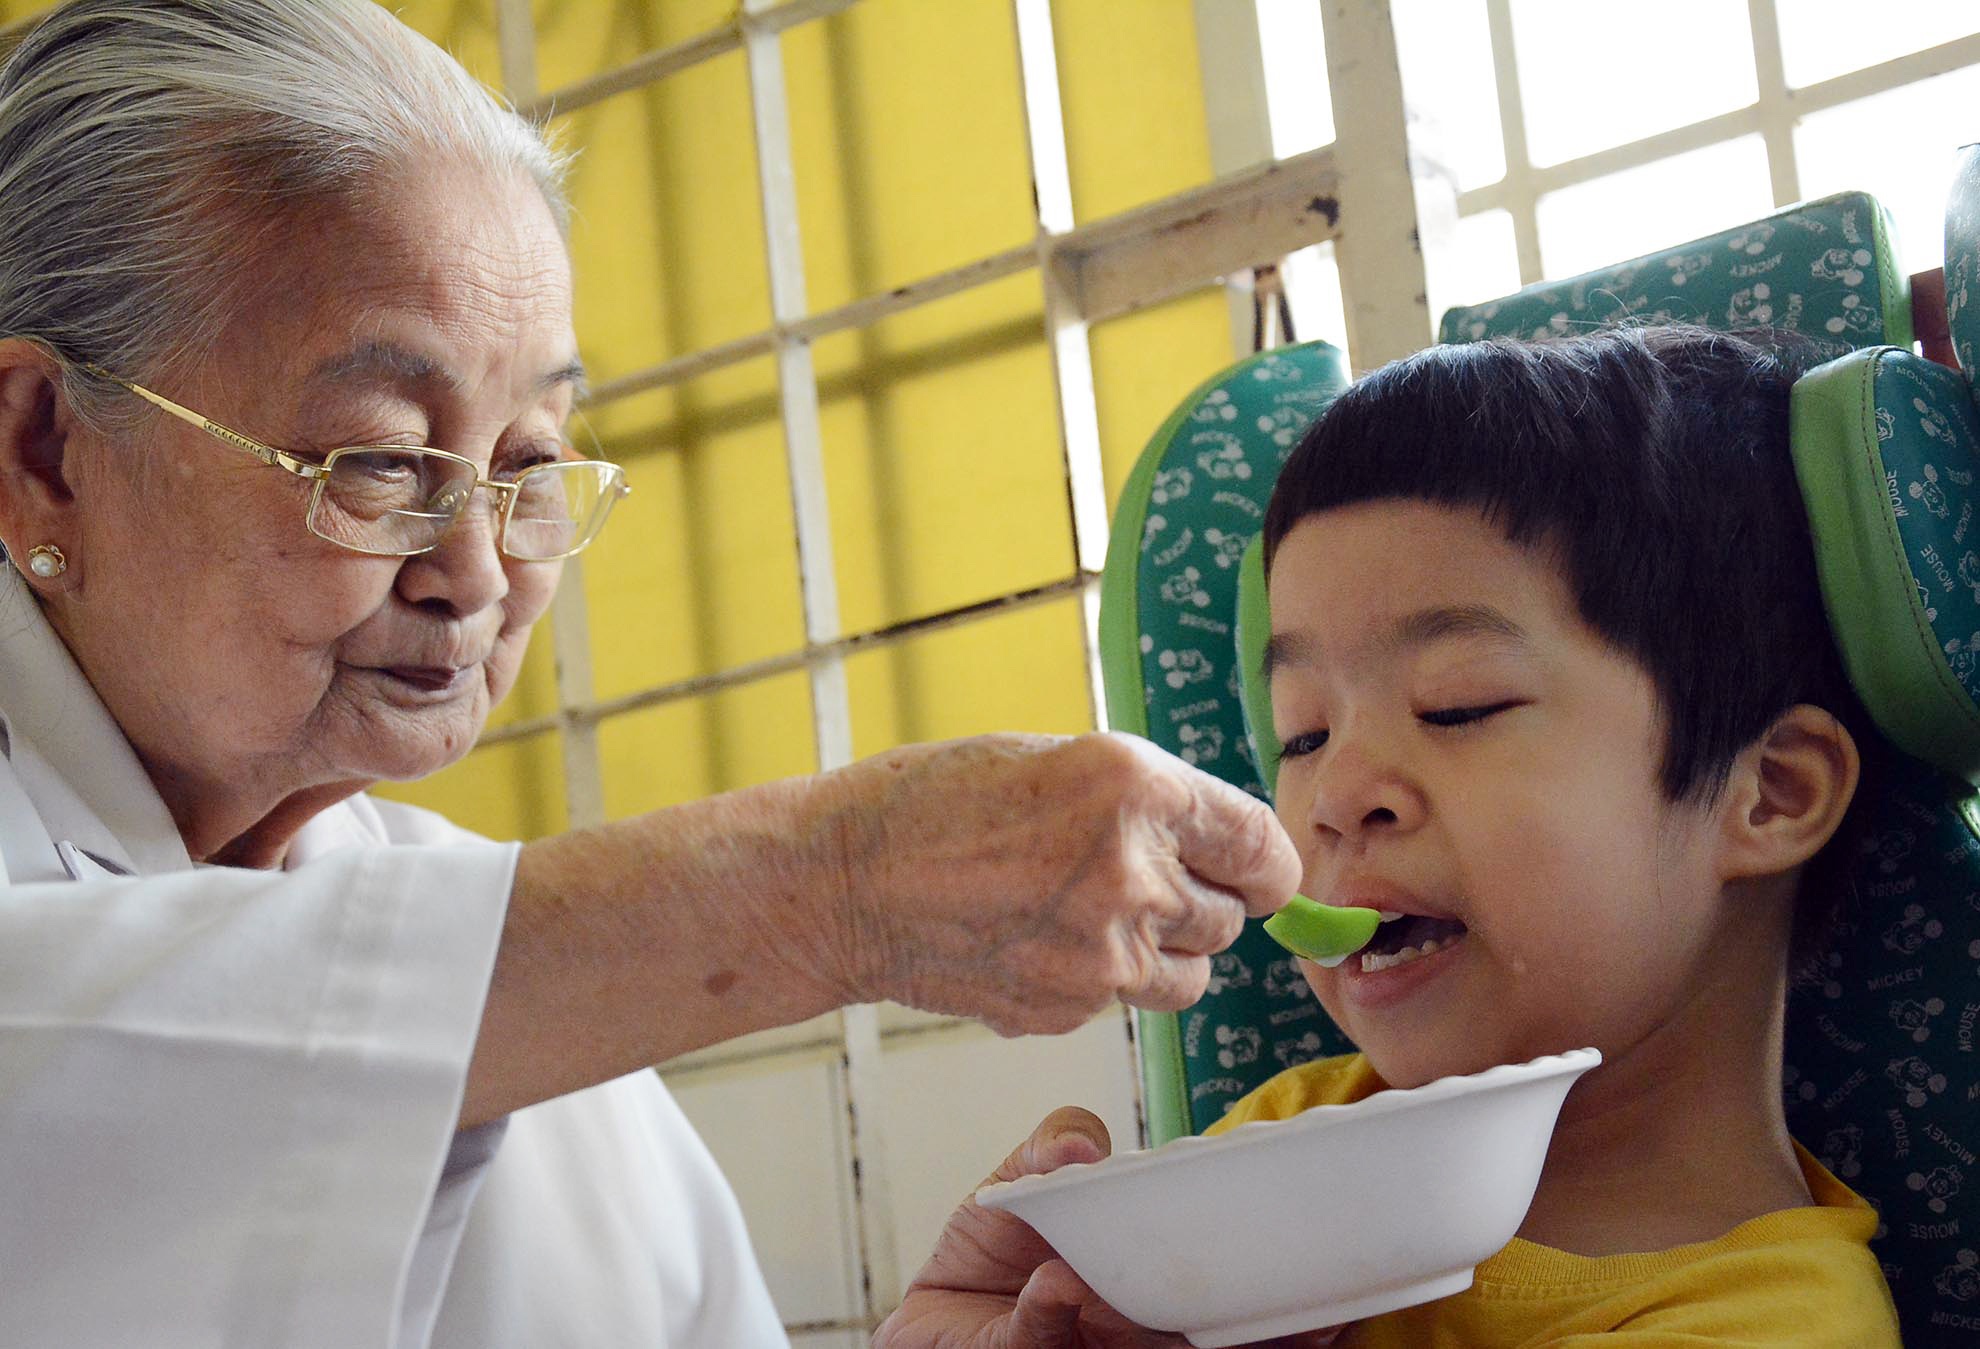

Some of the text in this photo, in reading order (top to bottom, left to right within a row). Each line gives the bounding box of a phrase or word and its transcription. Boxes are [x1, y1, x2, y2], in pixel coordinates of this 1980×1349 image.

[1886, 469, 1909, 518] MOUSE
[1919, 544, 1956, 593] MOUSE
[1867, 963, 1924, 992] MICKEY
[1957, 1001, 1980, 1053] MOUSE
[1822, 1067, 1872, 1111] MOUSE
[1886, 1106, 1911, 1159] MOUSE
[1920, 1120, 1976, 1166] MICKEY
[1908, 1217, 1960, 1241] MOUSE
